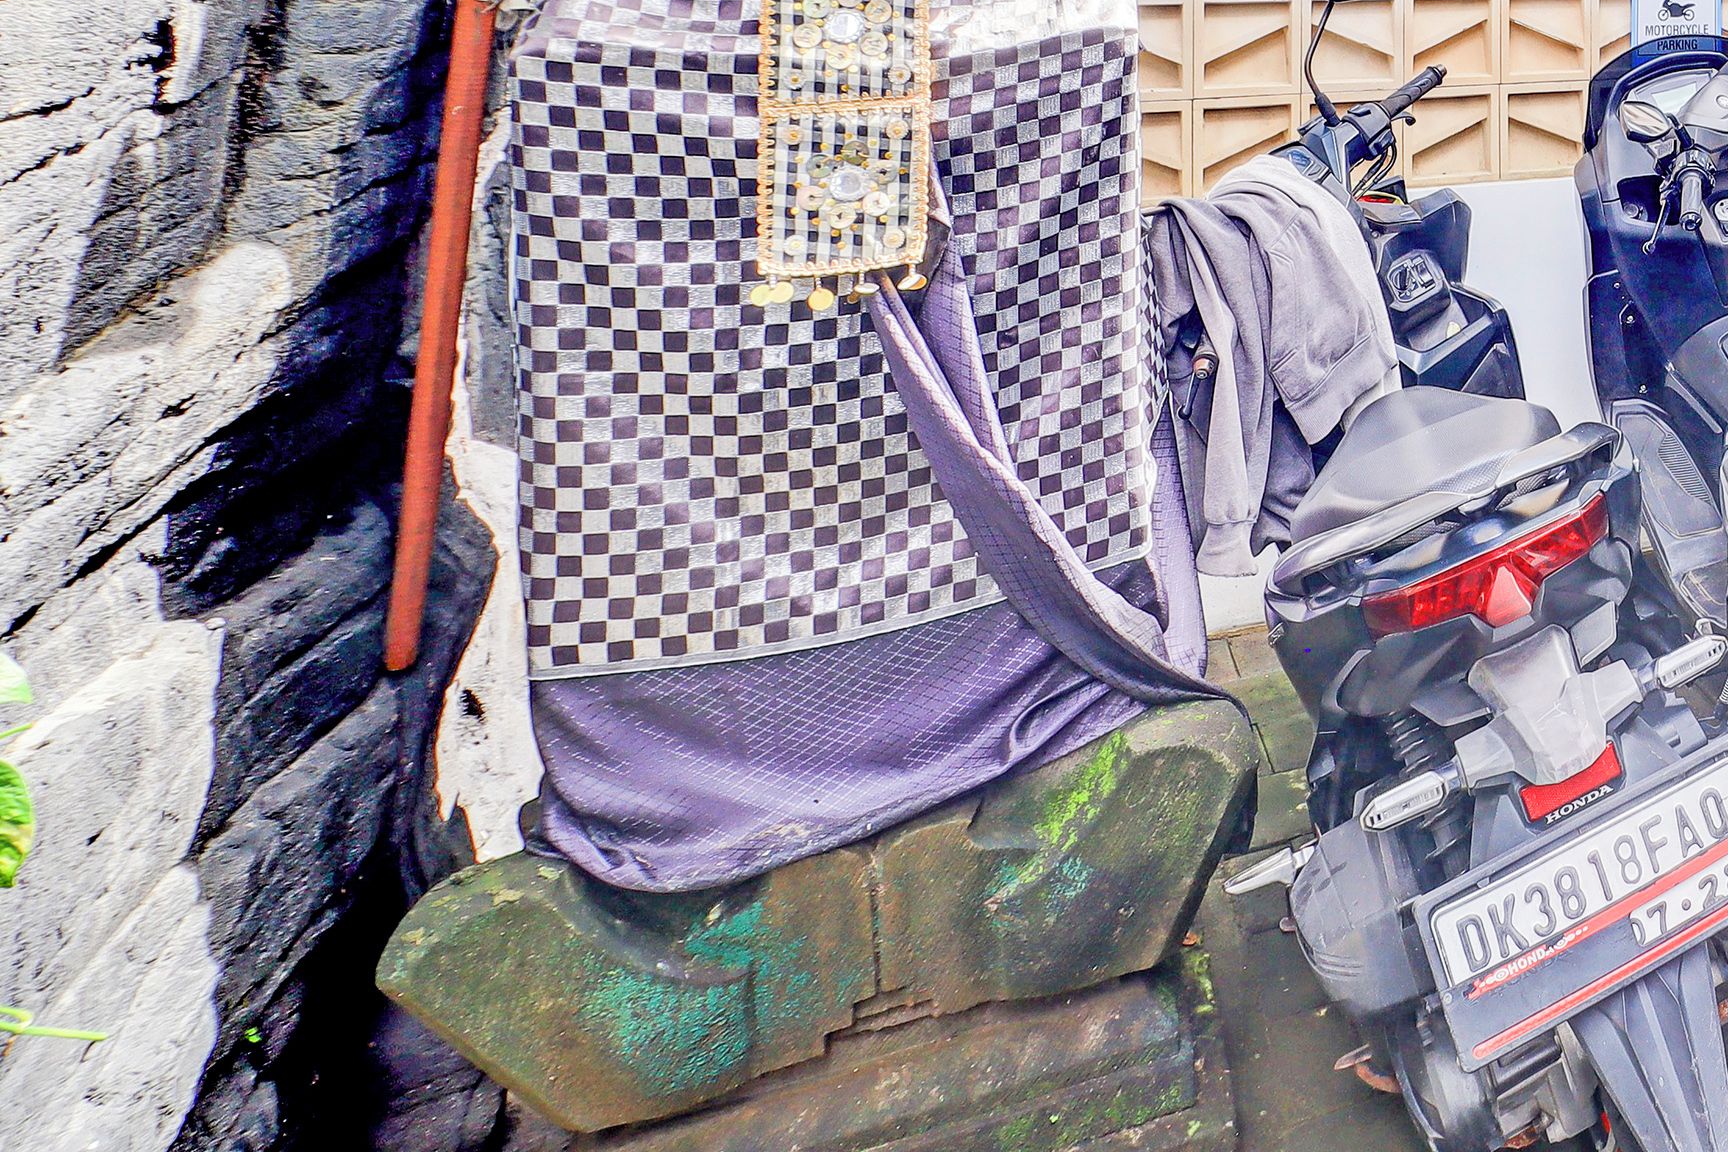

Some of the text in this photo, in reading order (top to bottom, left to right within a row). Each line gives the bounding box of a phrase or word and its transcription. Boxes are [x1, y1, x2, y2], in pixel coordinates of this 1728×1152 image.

[1645, 24, 1709, 36] MOTORCYCLE
[1657, 39, 1698, 50] PARKING
[1545, 783, 1613, 824] HONDA
